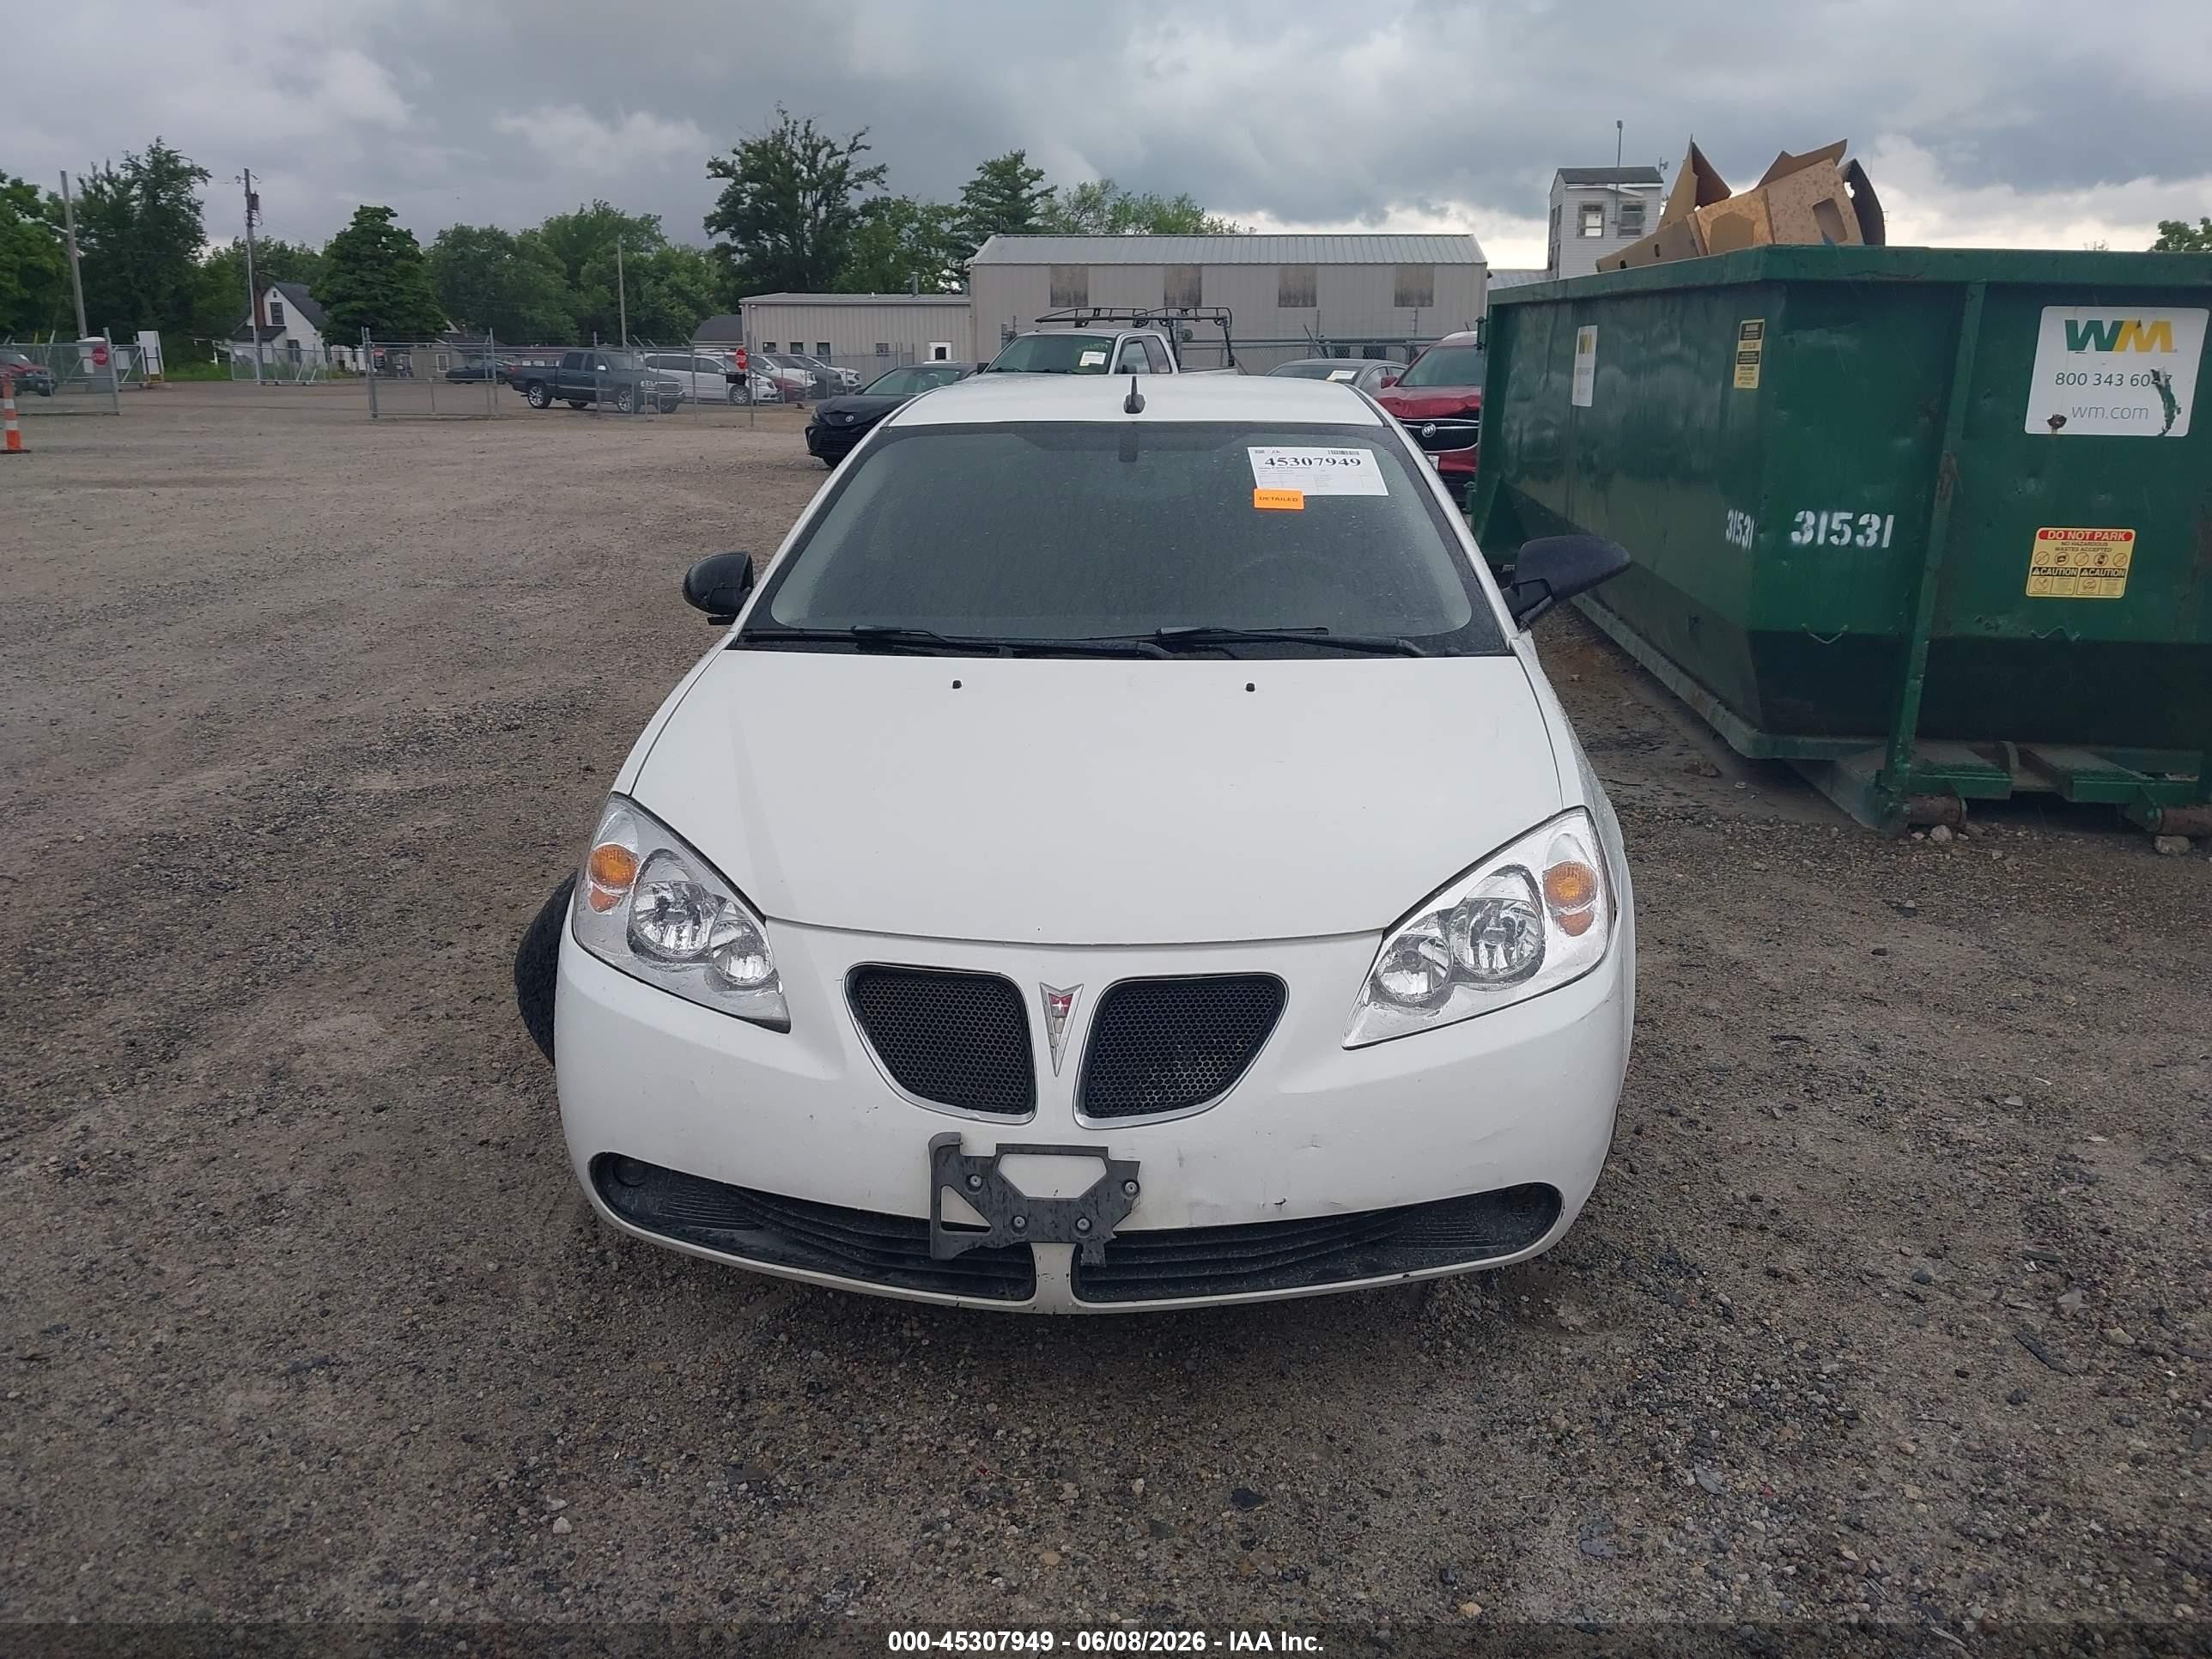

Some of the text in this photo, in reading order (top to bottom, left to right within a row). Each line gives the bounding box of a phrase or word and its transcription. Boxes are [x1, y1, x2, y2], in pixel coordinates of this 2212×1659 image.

[2064, 319, 2173, 353] WM
[2055, 373, 2087, 386] 800
[2093, 373, 2124, 386] 343
[2071, 405, 2149, 420] wm.com
[1264, 457, 1361, 467] 45307949
[1725, 508, 1755, 550] 31531
[1790, 510, 1895, 548] 31531
[2046, 530, 2127, 541] DO NOT PARK
[2039, 568, 2077, 576] CAUTION
[2088, 568, 2125, 577] CAUTION
